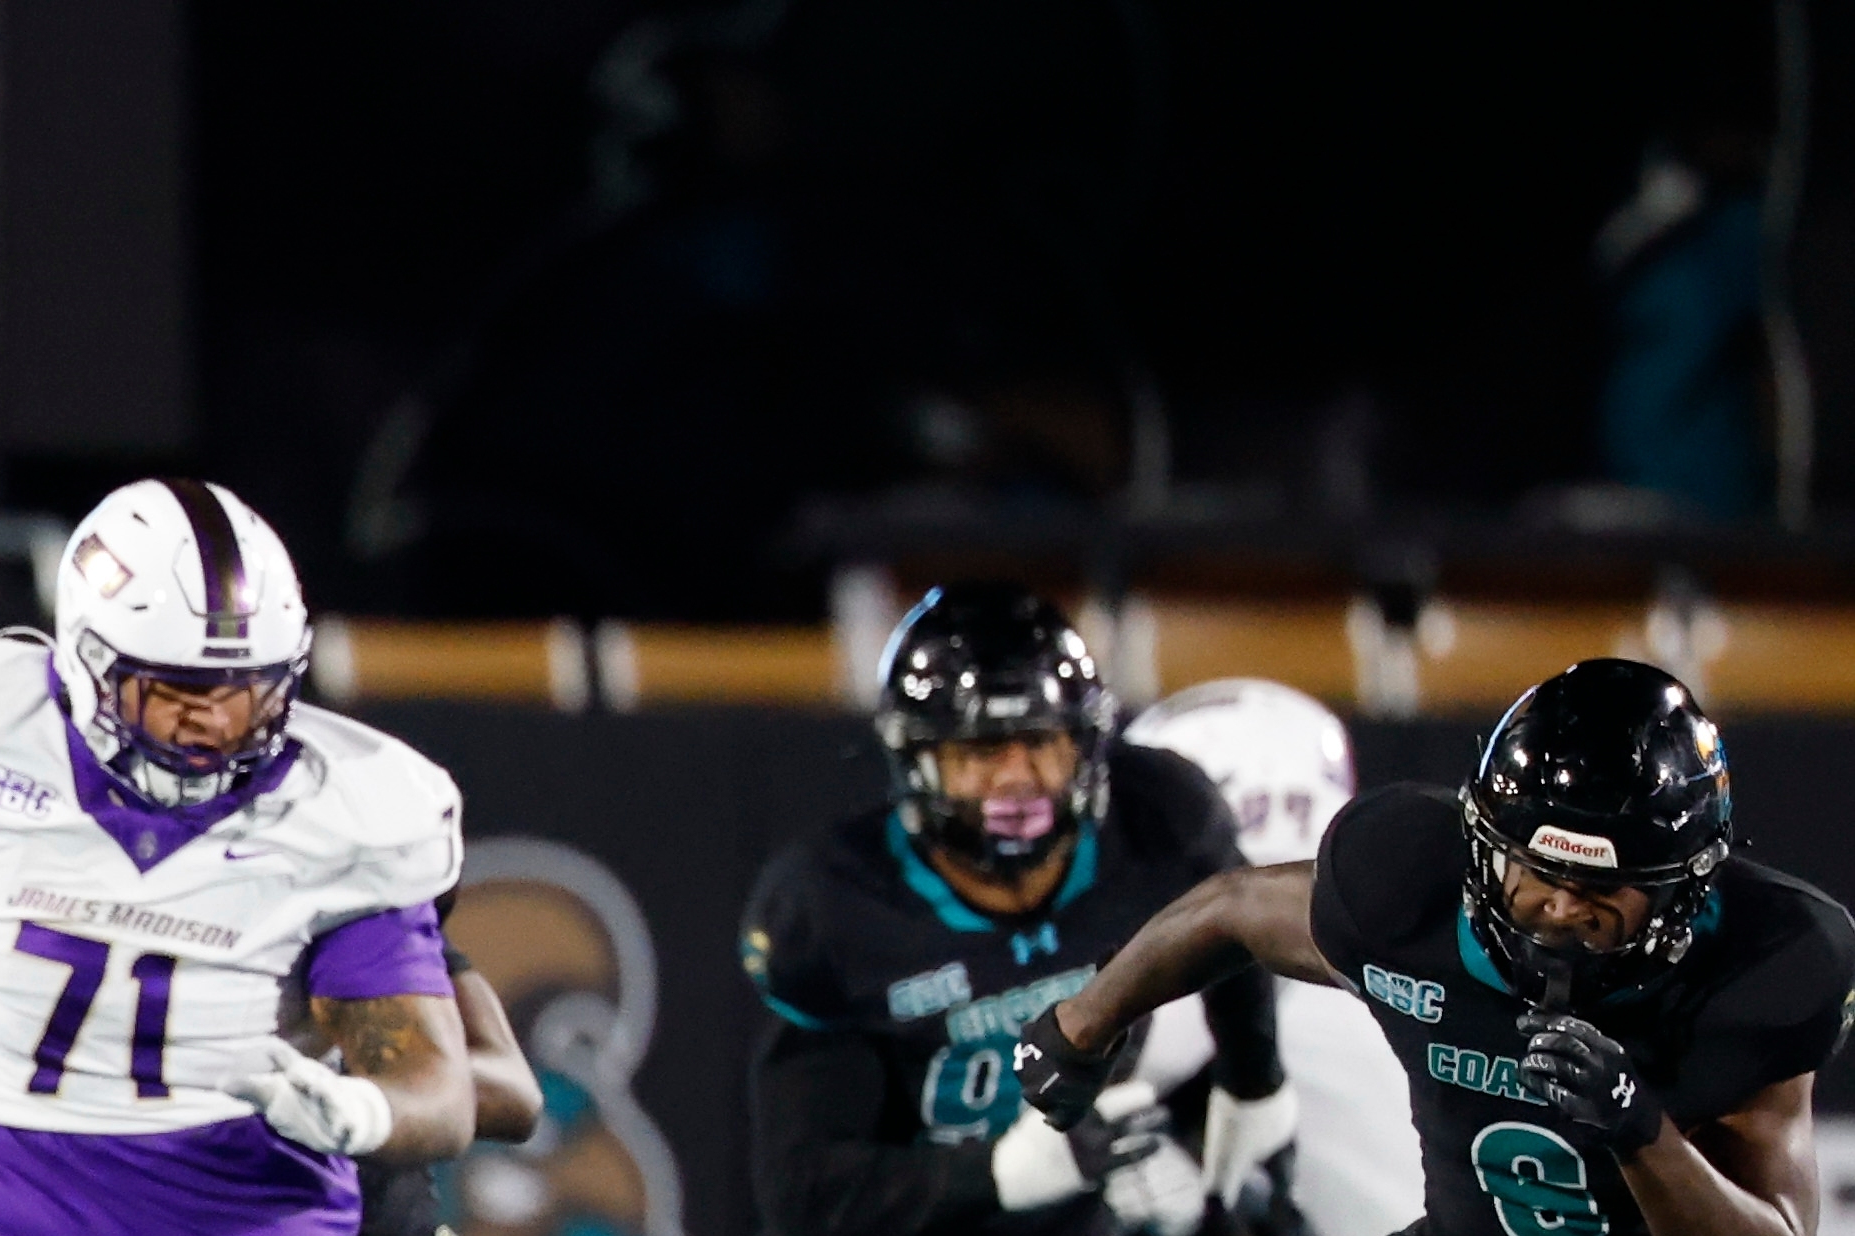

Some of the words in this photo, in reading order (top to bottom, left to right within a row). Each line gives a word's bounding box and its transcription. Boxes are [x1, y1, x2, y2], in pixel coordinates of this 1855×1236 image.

[1538, 834, 1609, 857] Riddell
[108, 903, 243, 950] MADISON
[12, 917, 178, 1099] 71
[1428, 1043, 1549, 1106] COA
